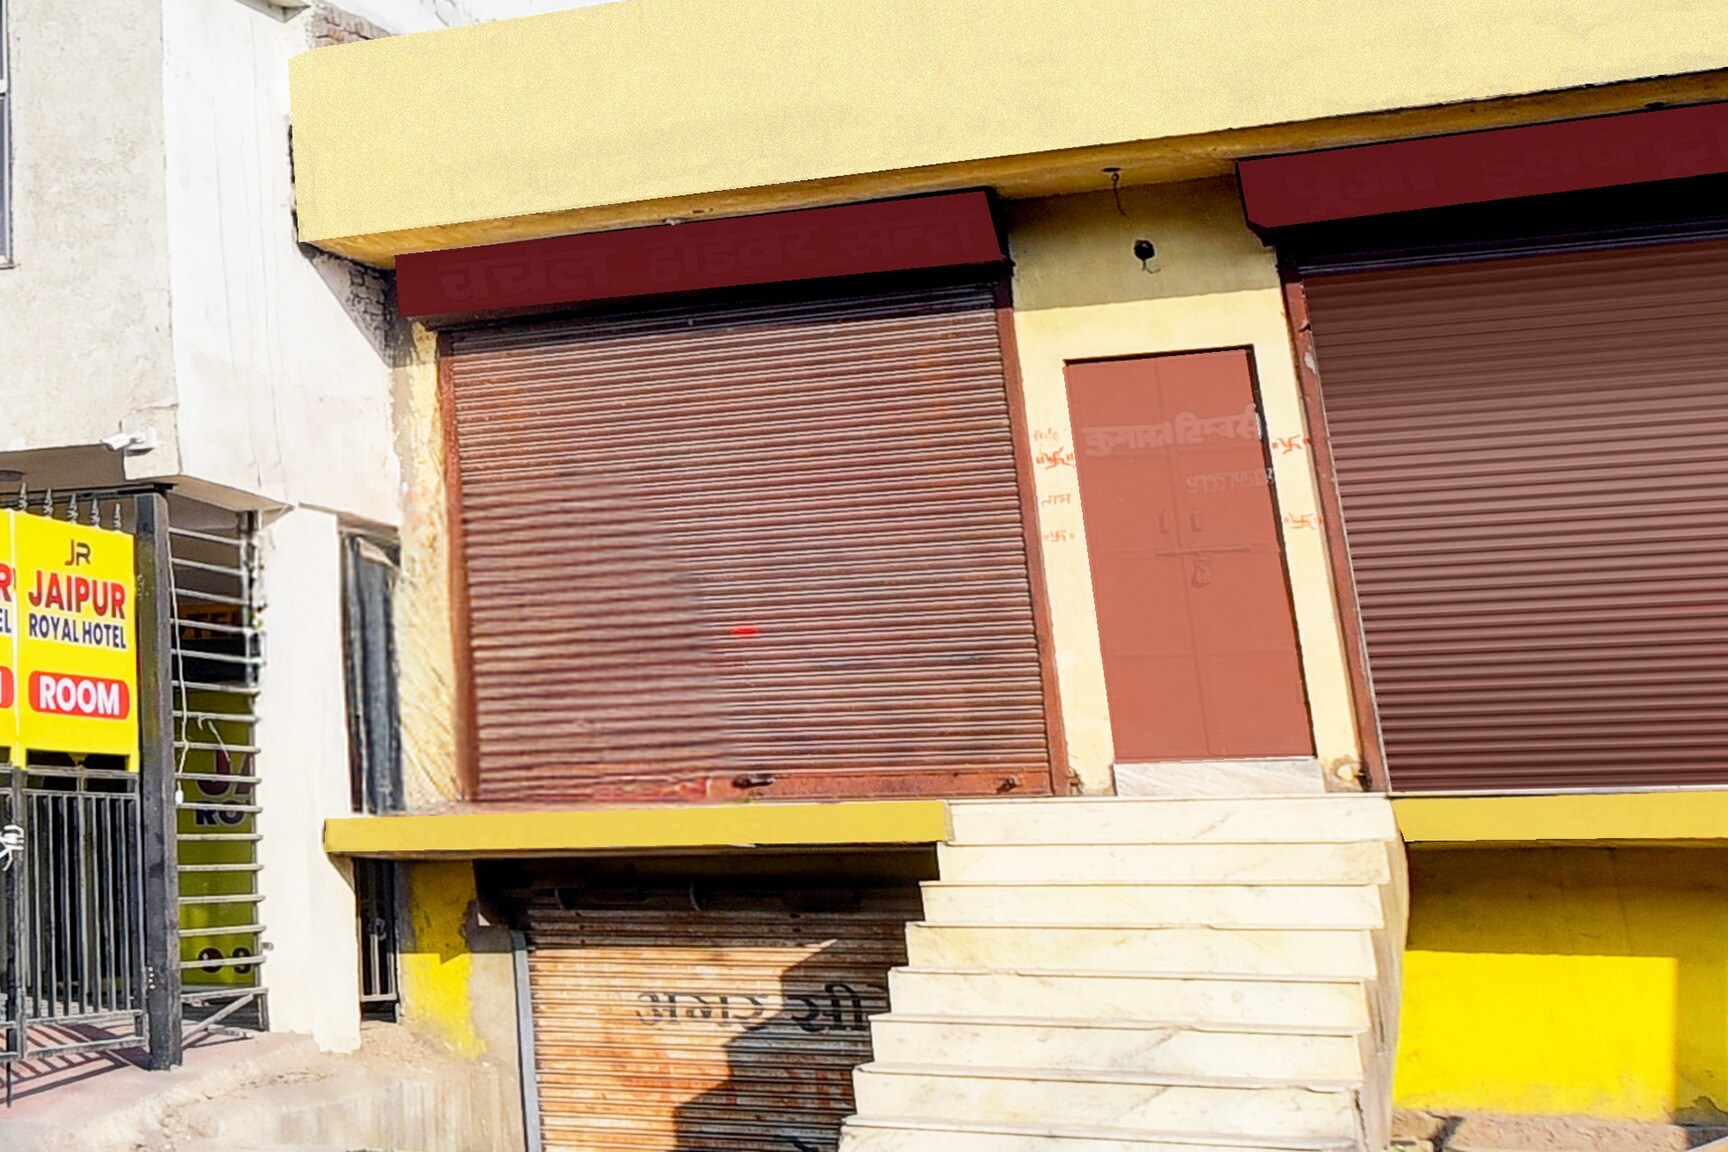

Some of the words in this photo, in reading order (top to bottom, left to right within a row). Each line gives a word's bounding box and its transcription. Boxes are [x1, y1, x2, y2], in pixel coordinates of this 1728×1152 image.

[64, 539, 91, 566] JR
[28, 569, 126, 619] JAIPUR
[28, 612, 79, 643] ROYAL
[82, 622, 127, 649] HOTEL
[39, 675, 120, 715] ROOM
